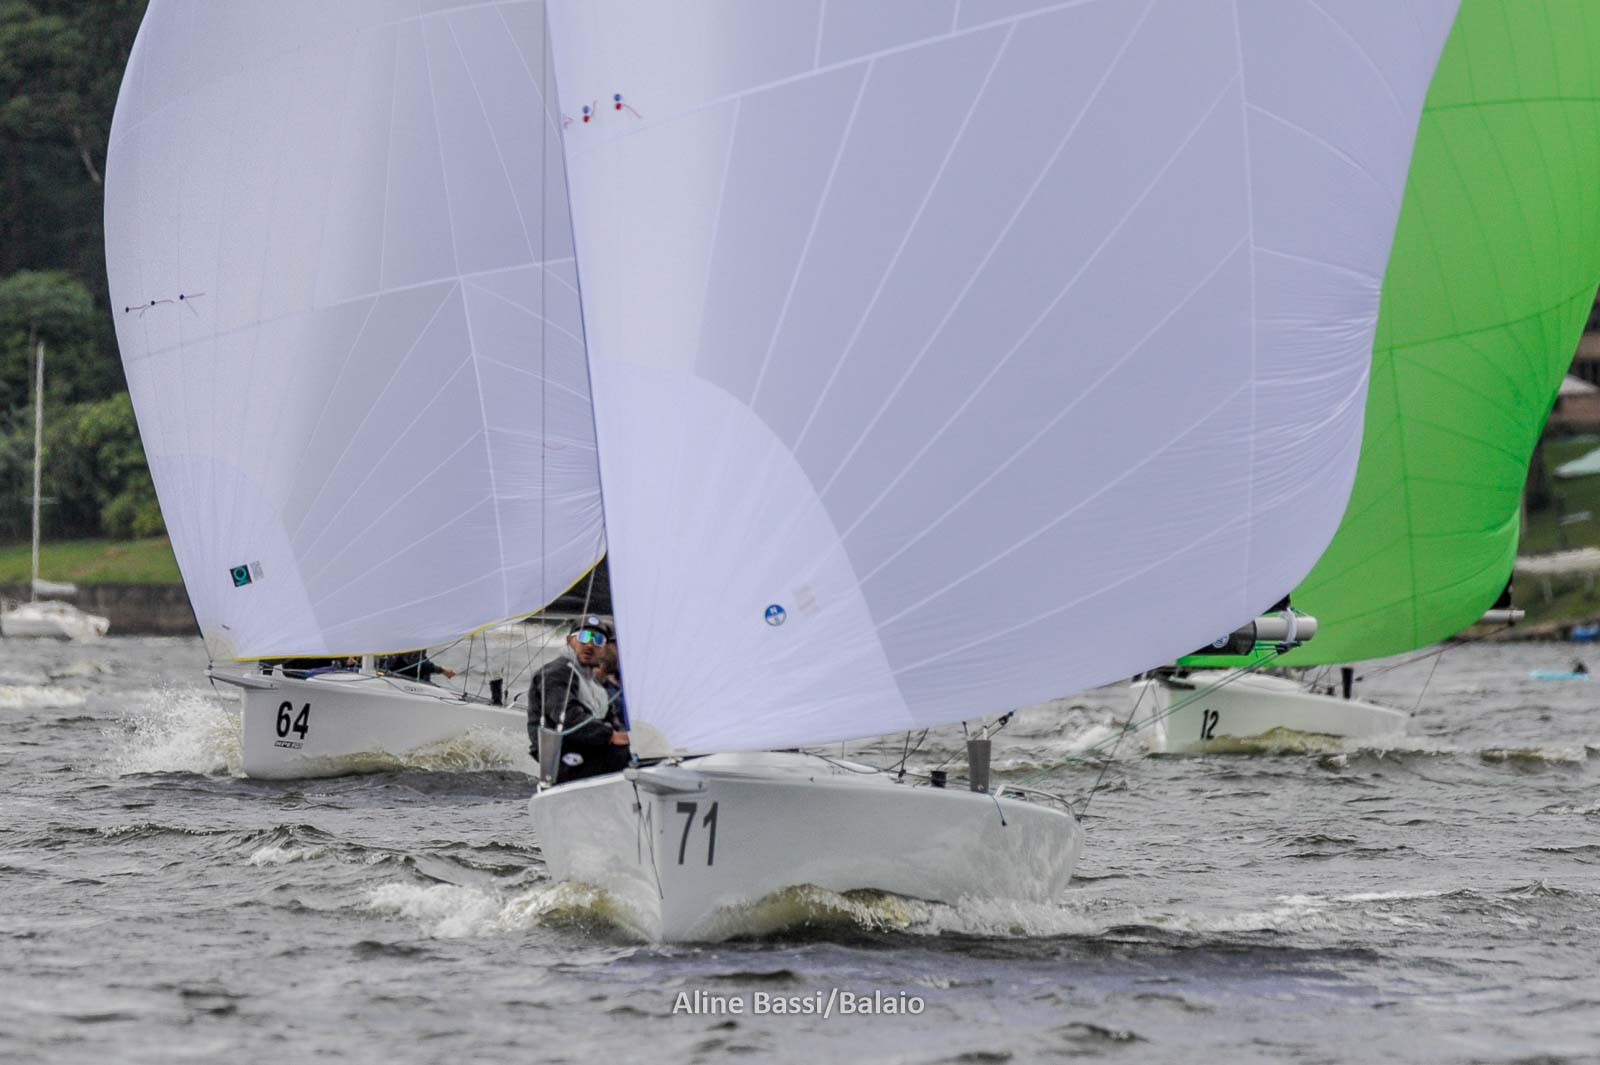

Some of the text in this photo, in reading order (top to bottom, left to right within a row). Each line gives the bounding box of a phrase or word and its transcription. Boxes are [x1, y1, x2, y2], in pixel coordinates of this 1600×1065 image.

[276, 701, 311, 740] 64
[1201, 709, 1219, 740] 12
[676, 801, 719, 866] 71
